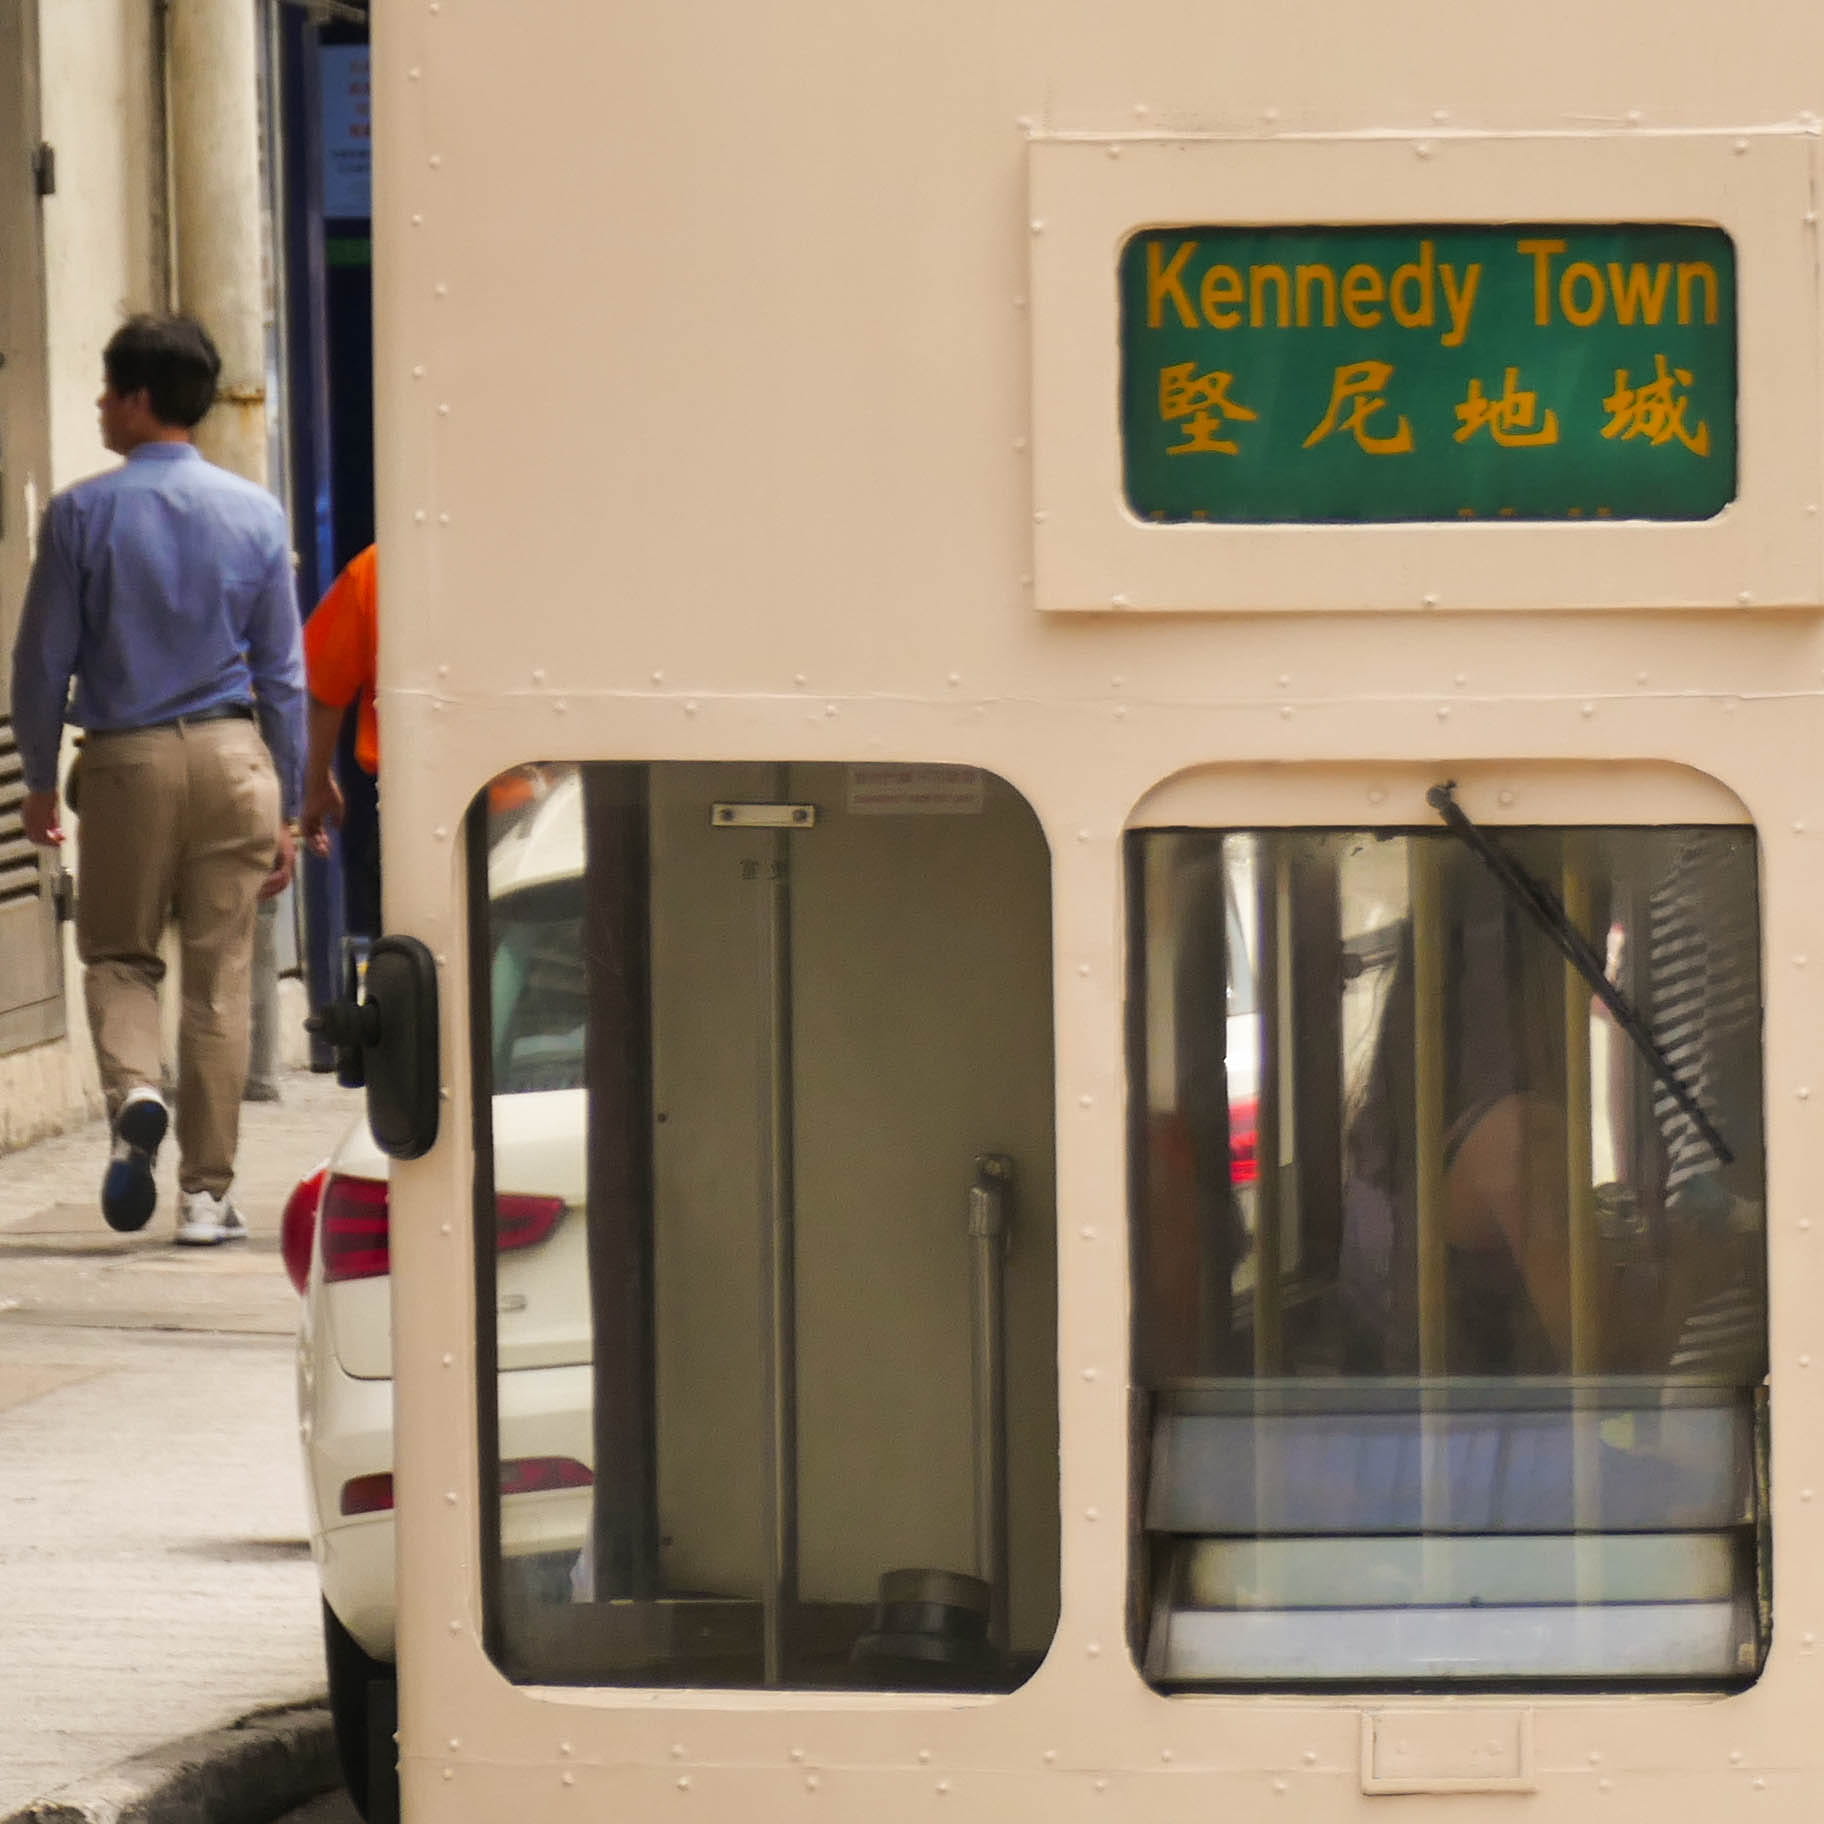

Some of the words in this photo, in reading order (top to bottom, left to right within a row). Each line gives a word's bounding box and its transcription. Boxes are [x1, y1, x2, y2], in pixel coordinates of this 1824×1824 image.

[1145, 239, 1482, 346] Kennedy
[1516, 238, 1720, 327] Town
[1157, 353, 1711, 458] 堅尼地城
